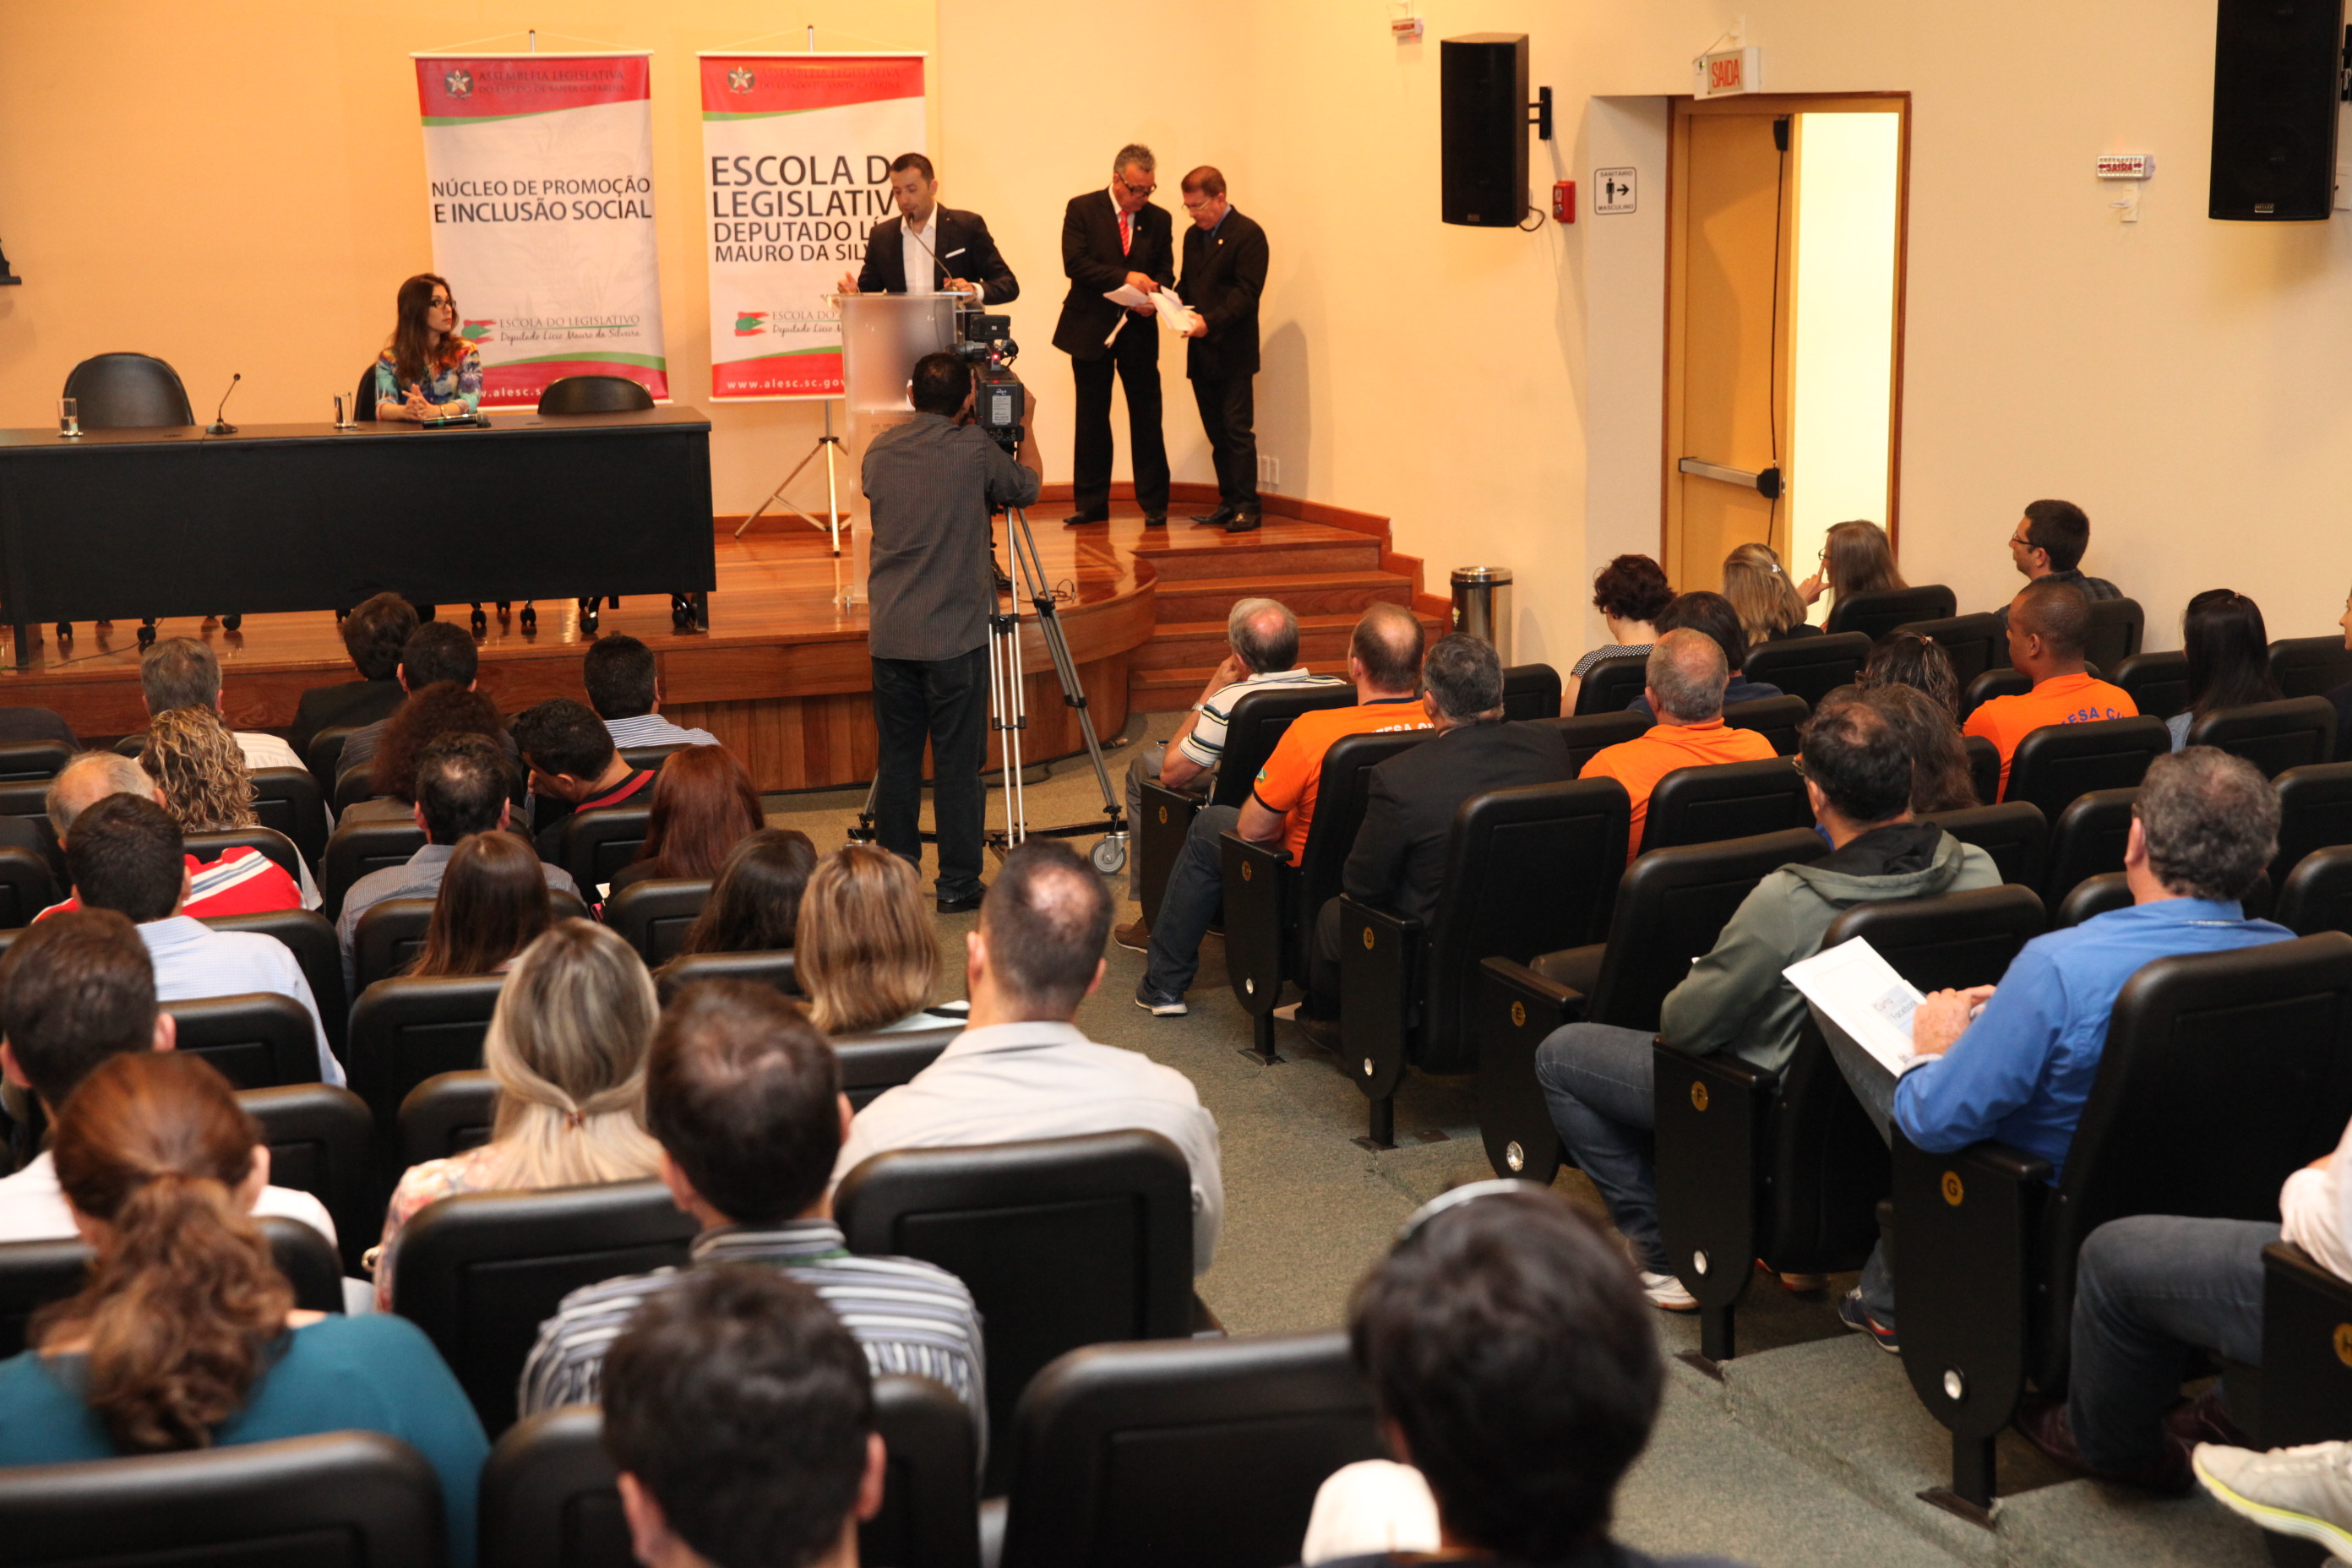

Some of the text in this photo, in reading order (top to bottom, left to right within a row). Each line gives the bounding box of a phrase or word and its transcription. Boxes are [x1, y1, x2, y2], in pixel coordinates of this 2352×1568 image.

[553, 69, 623, 80] LEGISLATIVA
[712, 155, 891, 186] ESCOLA D
[432, 175, 650, 198] NÚCLEO DE PROMOÇÃO
[434, 198, 652, 223] E INCLUSÃO SOCIAL
[713, 189, 894, 218] LEGISLATIV
[715, 220, 852, 242] DEPUTADO
[716, 244, 794, 262] MAURO
[801, 244, 829, 261] DA
[500, 313, 640, 329] ESCOLA DO LEGISLATIVO
[772, 310, 814, 320] ESCOLA
[817, 310, 835, 320] DO
[501, 330, 541, 346] Deputado
